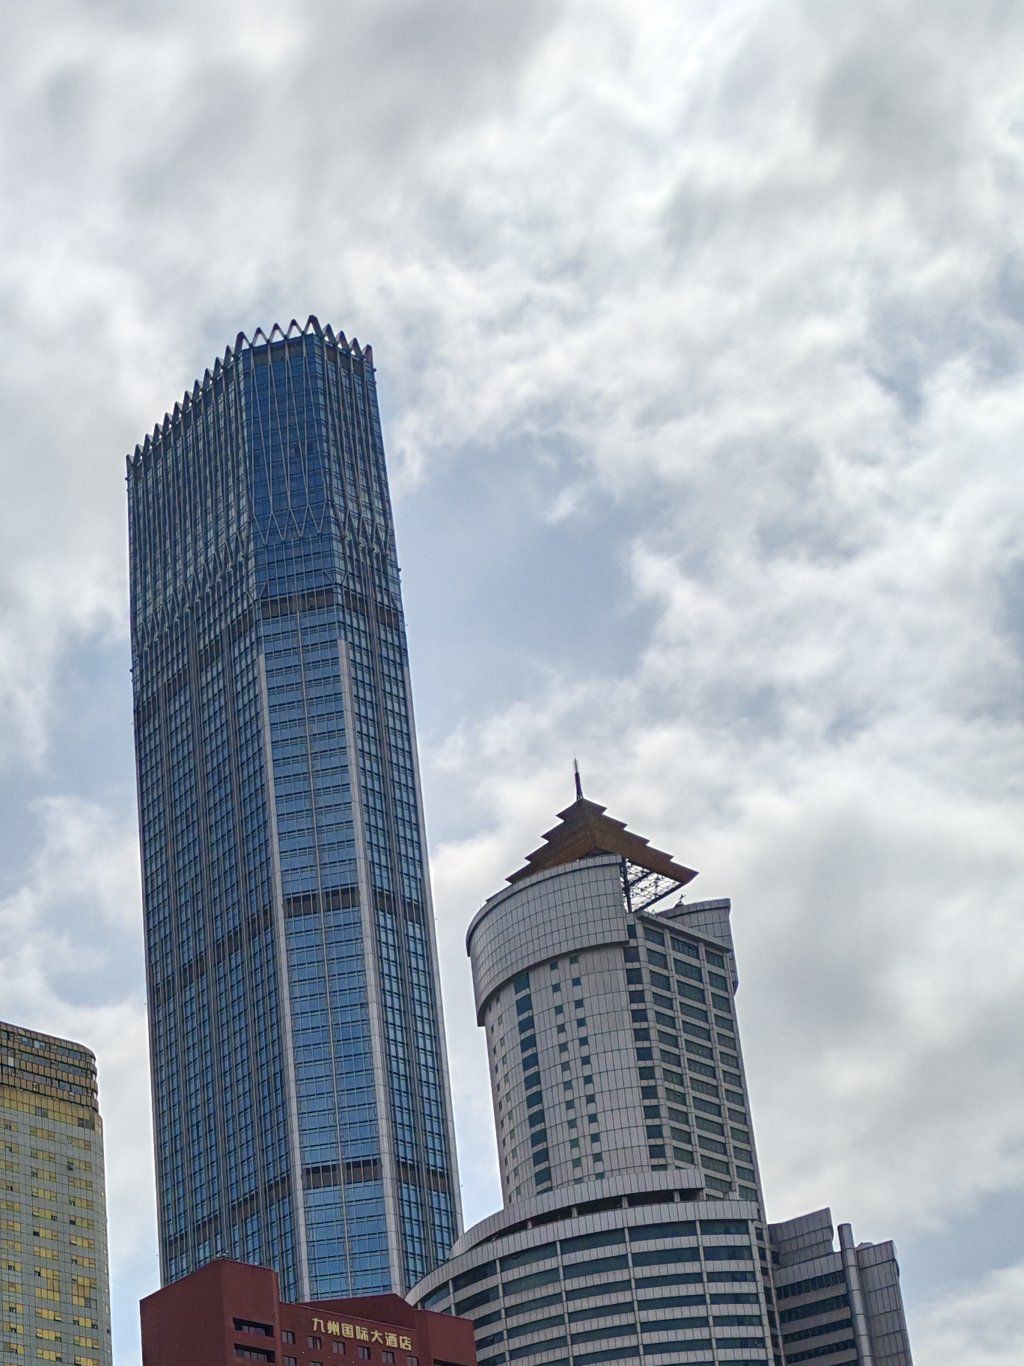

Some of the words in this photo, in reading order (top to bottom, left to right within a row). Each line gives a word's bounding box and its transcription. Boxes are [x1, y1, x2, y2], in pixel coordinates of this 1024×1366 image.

[312, 1317, 412, 1350] 九州国际大酒店
